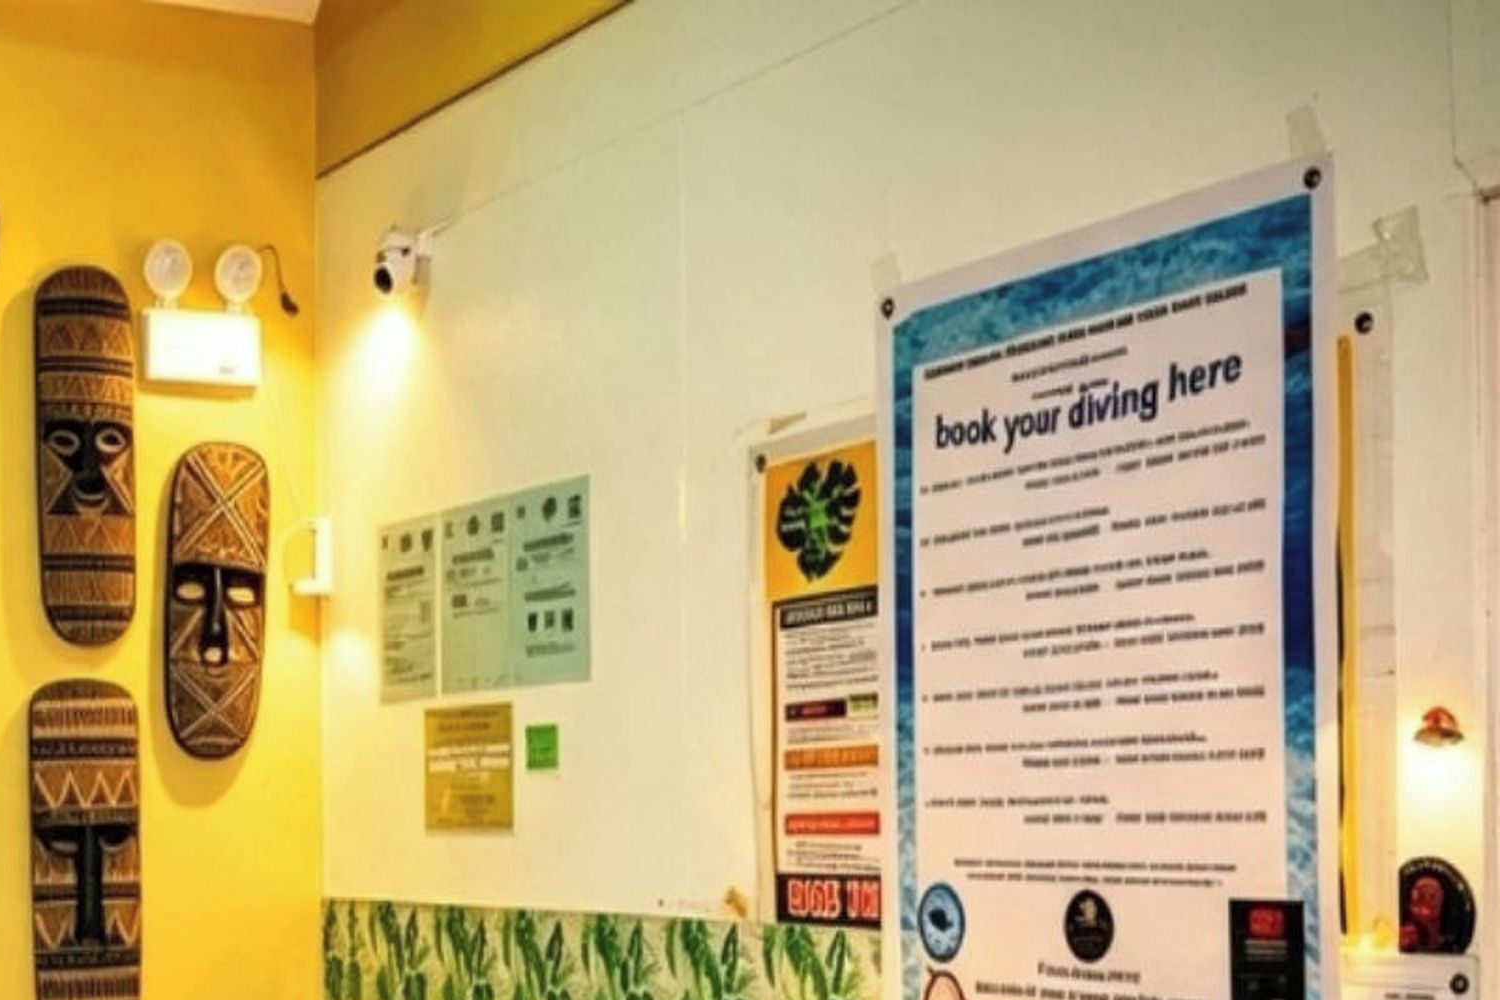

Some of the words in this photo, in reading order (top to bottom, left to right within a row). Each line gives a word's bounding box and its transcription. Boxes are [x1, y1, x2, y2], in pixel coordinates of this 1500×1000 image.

[935, 408, 997, 449] book
[1003, 404, 1061, 454] your
[1068, 380, 1159, 430] diving
[1168, 354, 1243, 402] here
